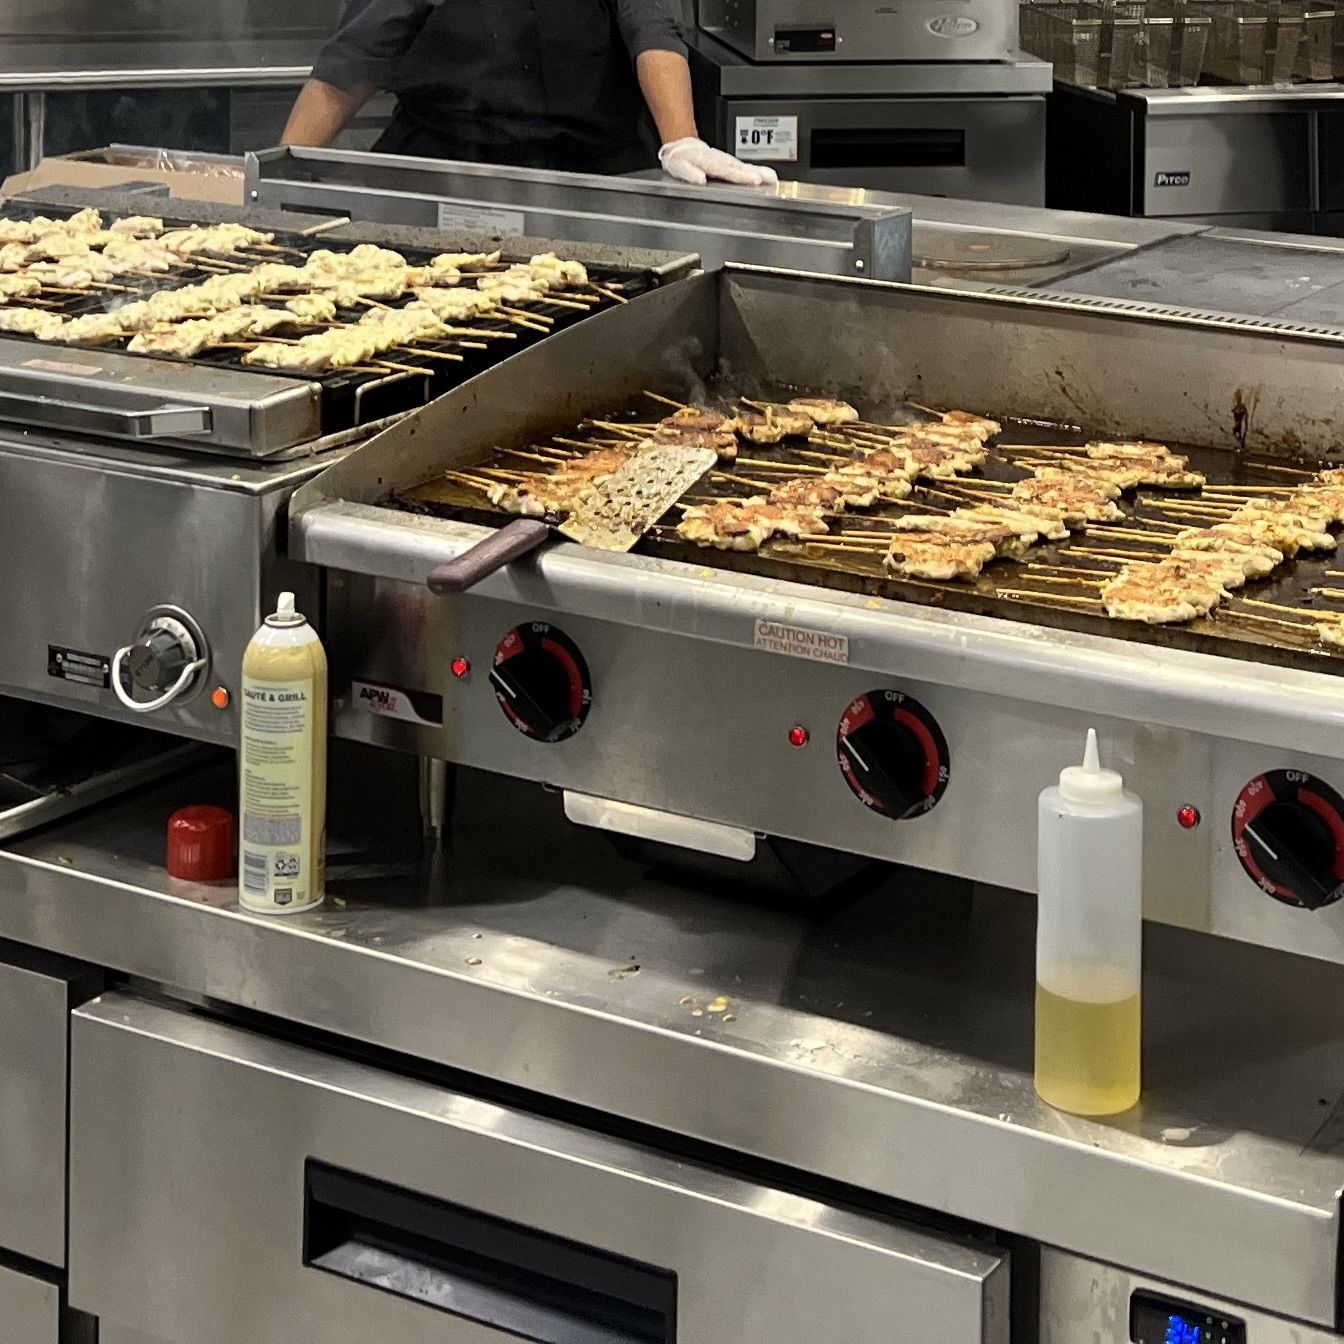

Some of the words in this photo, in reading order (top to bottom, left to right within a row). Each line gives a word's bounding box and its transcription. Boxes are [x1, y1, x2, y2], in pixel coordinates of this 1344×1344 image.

[532, 623, 550, 634] OFF
[758, 622, 815, 645] CAUTION
[818, 635, 846, 651] HOT
[756, 638, 811, 656] ATTENTION
[812, 647, 848, 663] CHAUD
[359, 687, 390, 704] APW
[884, 691, 905, 704] OFF
[1287, 771, 1308, 783] OFF
